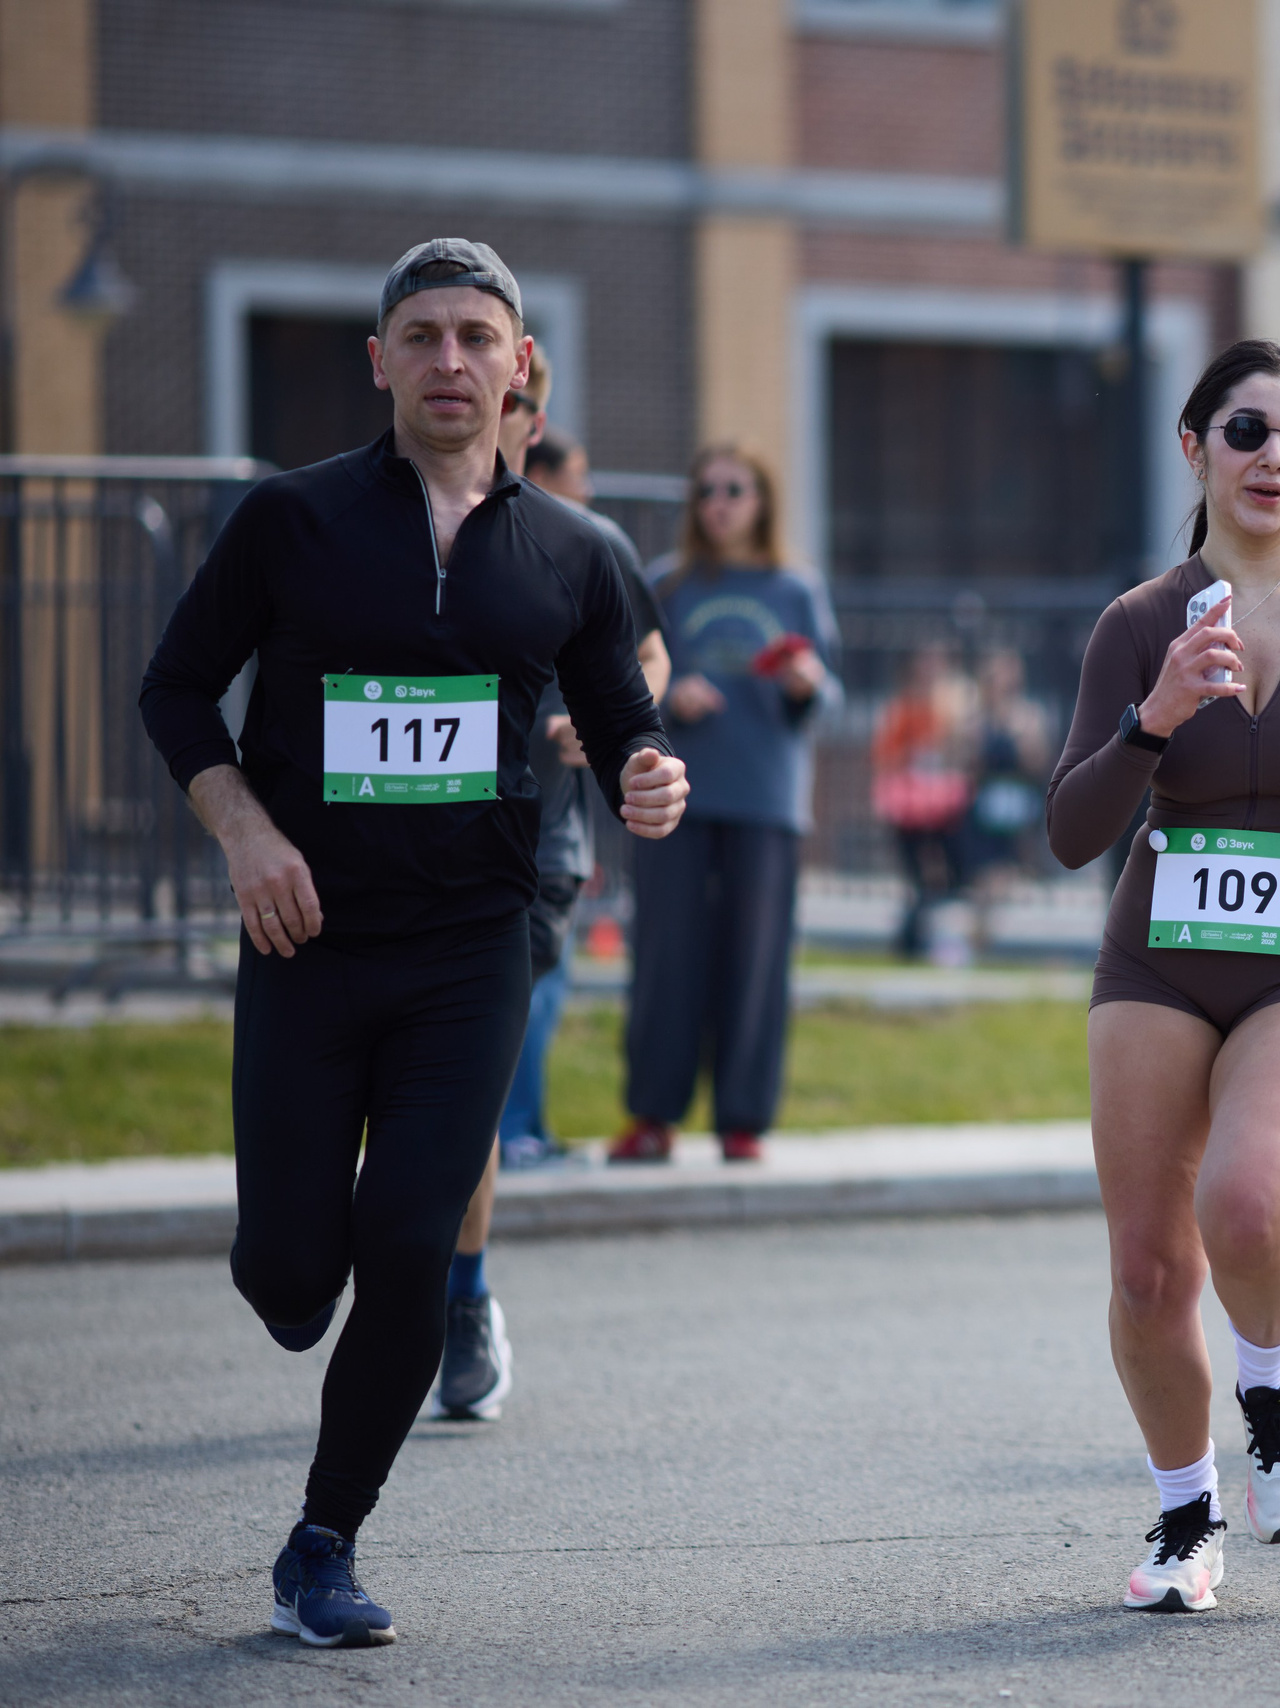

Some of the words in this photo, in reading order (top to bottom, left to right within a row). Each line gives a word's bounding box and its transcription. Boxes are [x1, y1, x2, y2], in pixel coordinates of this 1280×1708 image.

[409, 687, 436, 698] Звук
[371, 718, 460, 762] 117
[358, 777, 375, 796] A
[1229, 839, 1254, 850] Звук
[1193, 868, 1277, 914] 109
[1177, 924, 1192, 942] A
